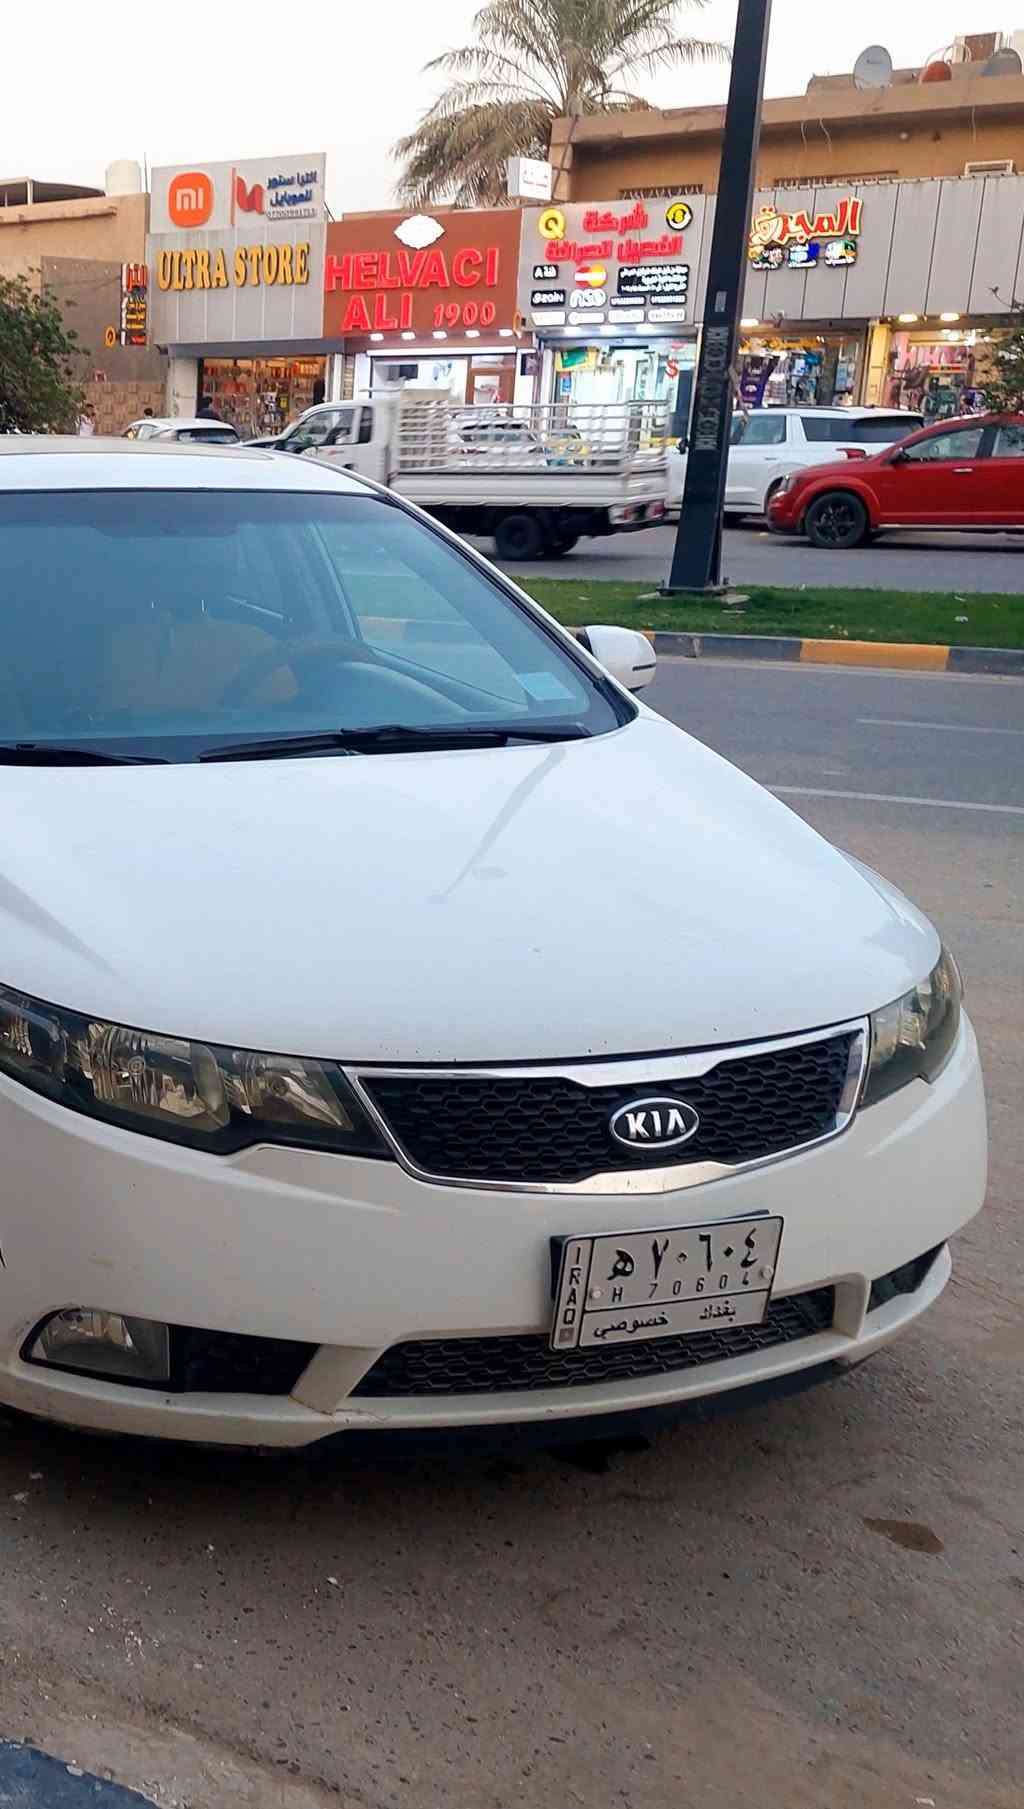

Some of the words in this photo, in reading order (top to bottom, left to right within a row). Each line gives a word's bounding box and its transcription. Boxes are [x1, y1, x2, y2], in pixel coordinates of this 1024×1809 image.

[157, 249, 229, 292] ULTRA
[232, 243, 310, 289] STORE
[325, 247, 500, 292] HELVACI
[341, 293, 413, 332] ALI
[433, 301, 496, 328] 1900
[625, 1109, 686, 1139] KIA
[563, 1246, 582, 1325] IRAQ
[611, 1286, 624, 1303] H
[594, 1312, 669, 1339] خصوصي
[699, 1300, 737, 1322] بغداد
